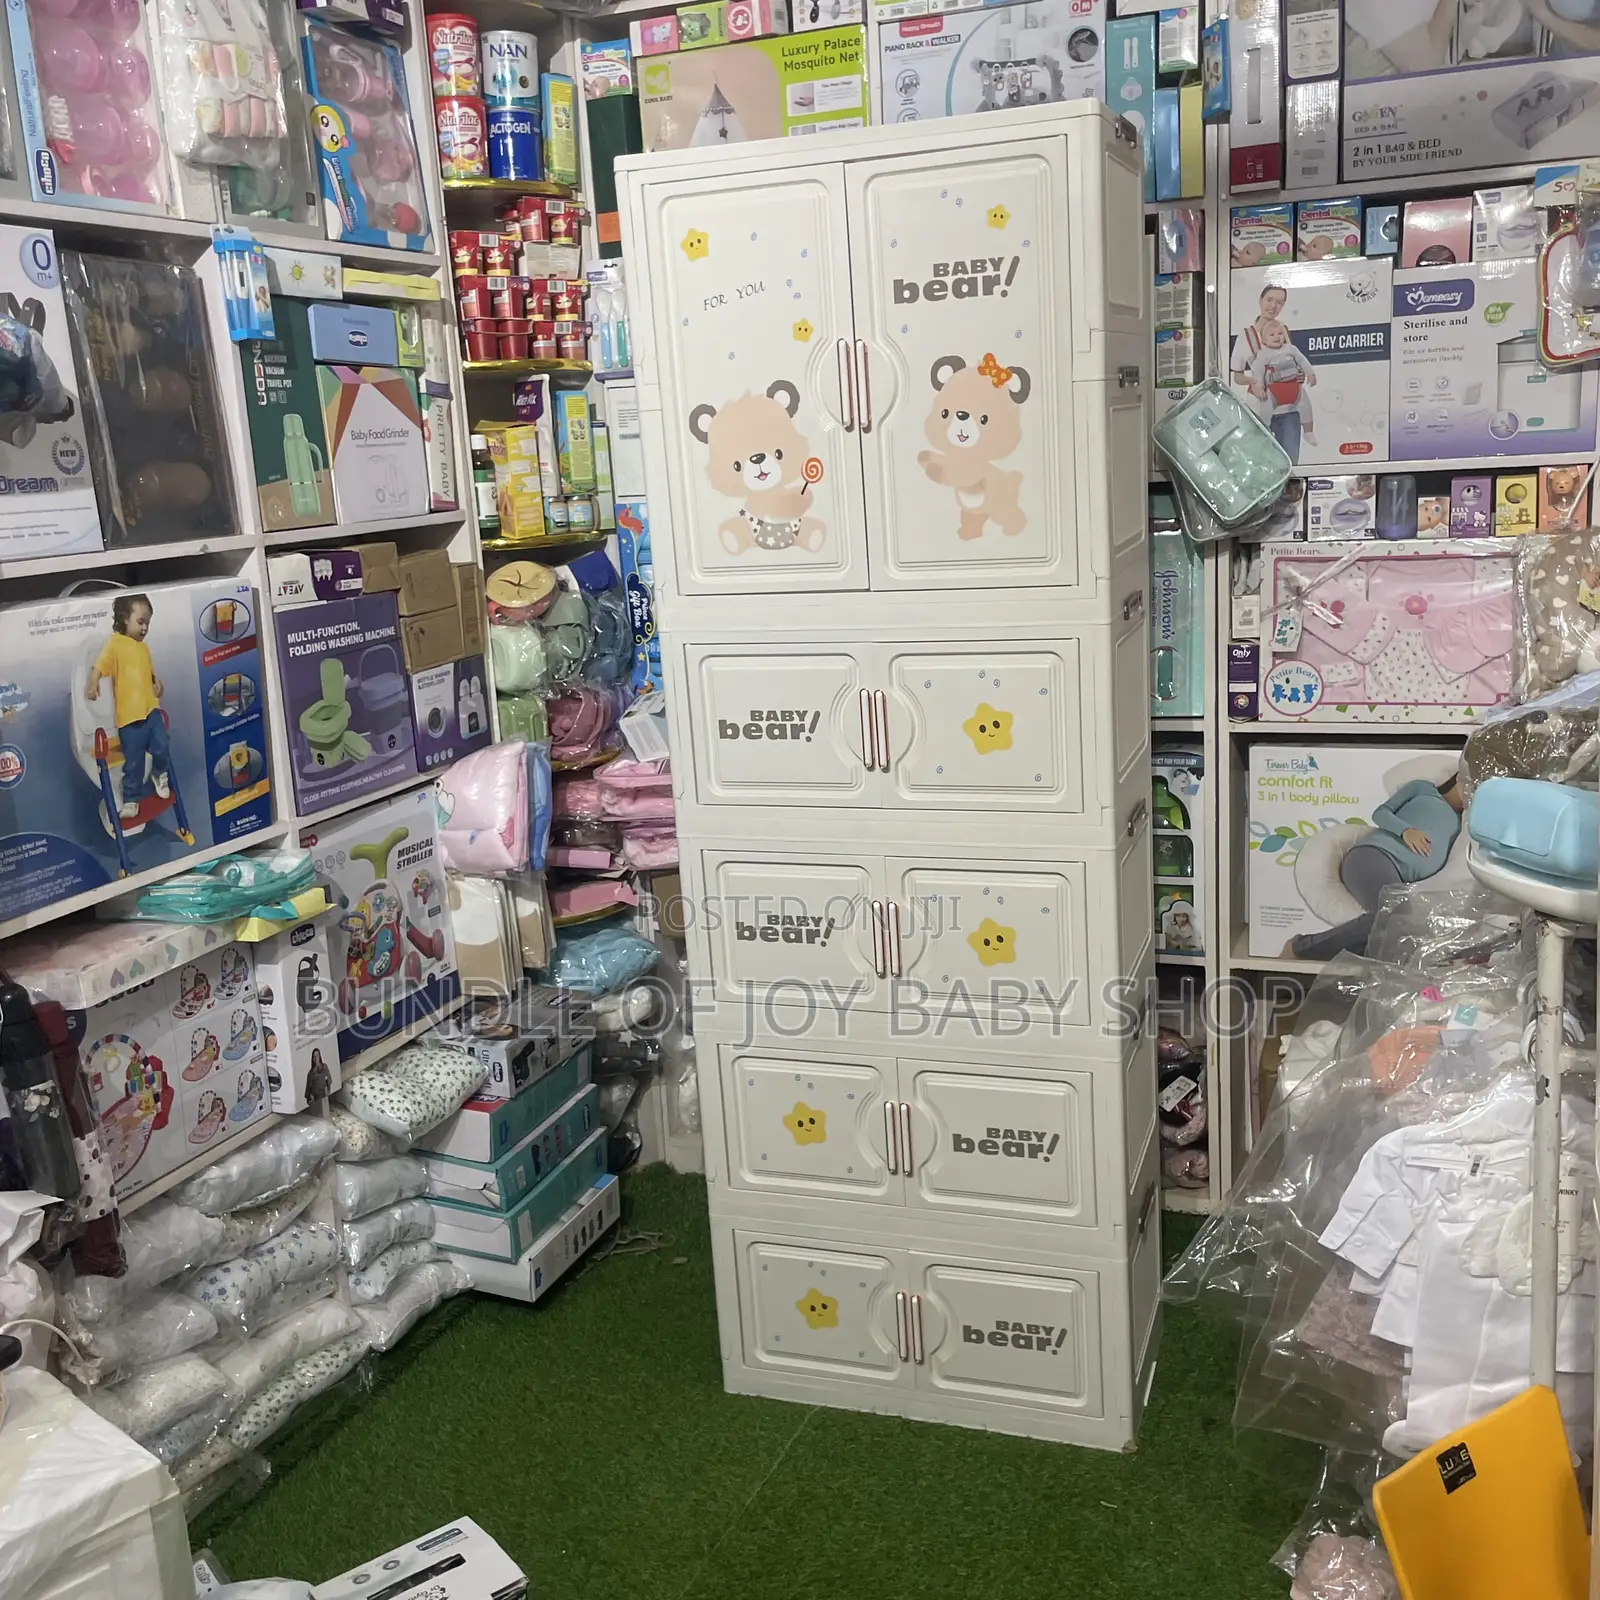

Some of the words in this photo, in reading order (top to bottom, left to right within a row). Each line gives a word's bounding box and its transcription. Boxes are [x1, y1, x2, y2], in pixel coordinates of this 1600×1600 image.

[489, 44, 528, 59] NAN
[781, 43, 820, 57] Luxury
[824, 37, 861, 50] Palace
[884, 43, 906, 53] PIANO
[906, 41, 924, 50] RACK
[931, 35, 960, 46] WALKER
[784, 55, 836, 71] Mosquito
[839, 51, 860, 63] Net
[1353, 147, 1360, 157] 2
[1363, 145, 1374, 155] in
[1385, 143, 1405, 153] BAG
[1407, 141, 1416, 150] &
[1418, 138, 1441, 149] BED
[1352, 160, 1366, 168] BY
[1368, 156, 1397, 167] YOUR
[1425, 148, 1463, 159] FRIEND
[1234, 216, 1263, 226] Dental
[1301, 210, 1331, 220] Dental
[933, 256, 1005, 278] BABY
[892, 256, 1020, 304] bear!
[703, 294, 728, 311] FOR
[736, 281, 766, 300] YOU
[1403, 318, 1446, 330] Sterilise
[1449, 316, 1468, 326] and
[1308, 335, 1337, 351] BABY
[1338, 332, 1384, 349] CARRIER
[1403, 334, 1428, 342] store
[351, 430, 368, 442] Baby
[368, 429, 385, 439] Food
[385, 428, 409, 438] Grinder
[436, 403, 447, 456] PRETTY
[440, 462, 451, 497] BABY
[1270, 547, 1294, 555] Petite
[1296, 547, 1320, 555] Bears
[1153, 570, 1179, 640] Johnson's
[633, 608, 642, 628] Box
[289, 642, 327, 658] FOLDING
[327, 633, 364, 649] WASHING
[364, 625, 396, 641] MACHINE
[1232, 648, 1251, 658] Only
[1269, 668, 1294, 684] Petite
[1296, 667, 1319, 683] Bears
[749, 709, 808, 722] BABY
[718, 710, 821, 743] bear!
[1291, 758, 1309, 774] Baby
[1257, 775, 1315, 788] comfort
[1319, 776, 1334, 788] fit
[1257, 791, 1265, 801] 3
[1268, 791, 1278, 801] in
[1289, 791, 1319, 806] body
[1322, 793, 1360, 806] pillow
[397, 837, 434, 859] MUSICAL
[396, 848, 433, 870] STROLLER
[766, 914, 823, 928] BABY
[736, 917, 836, 947] bear!
[986, 1127, 1046, 1143] BABY
[952, 1133, 1060, 1162] bear!
[995, 1320, 1055, 1337] BABY
[962, 1325, 1068, 1355] bear!
